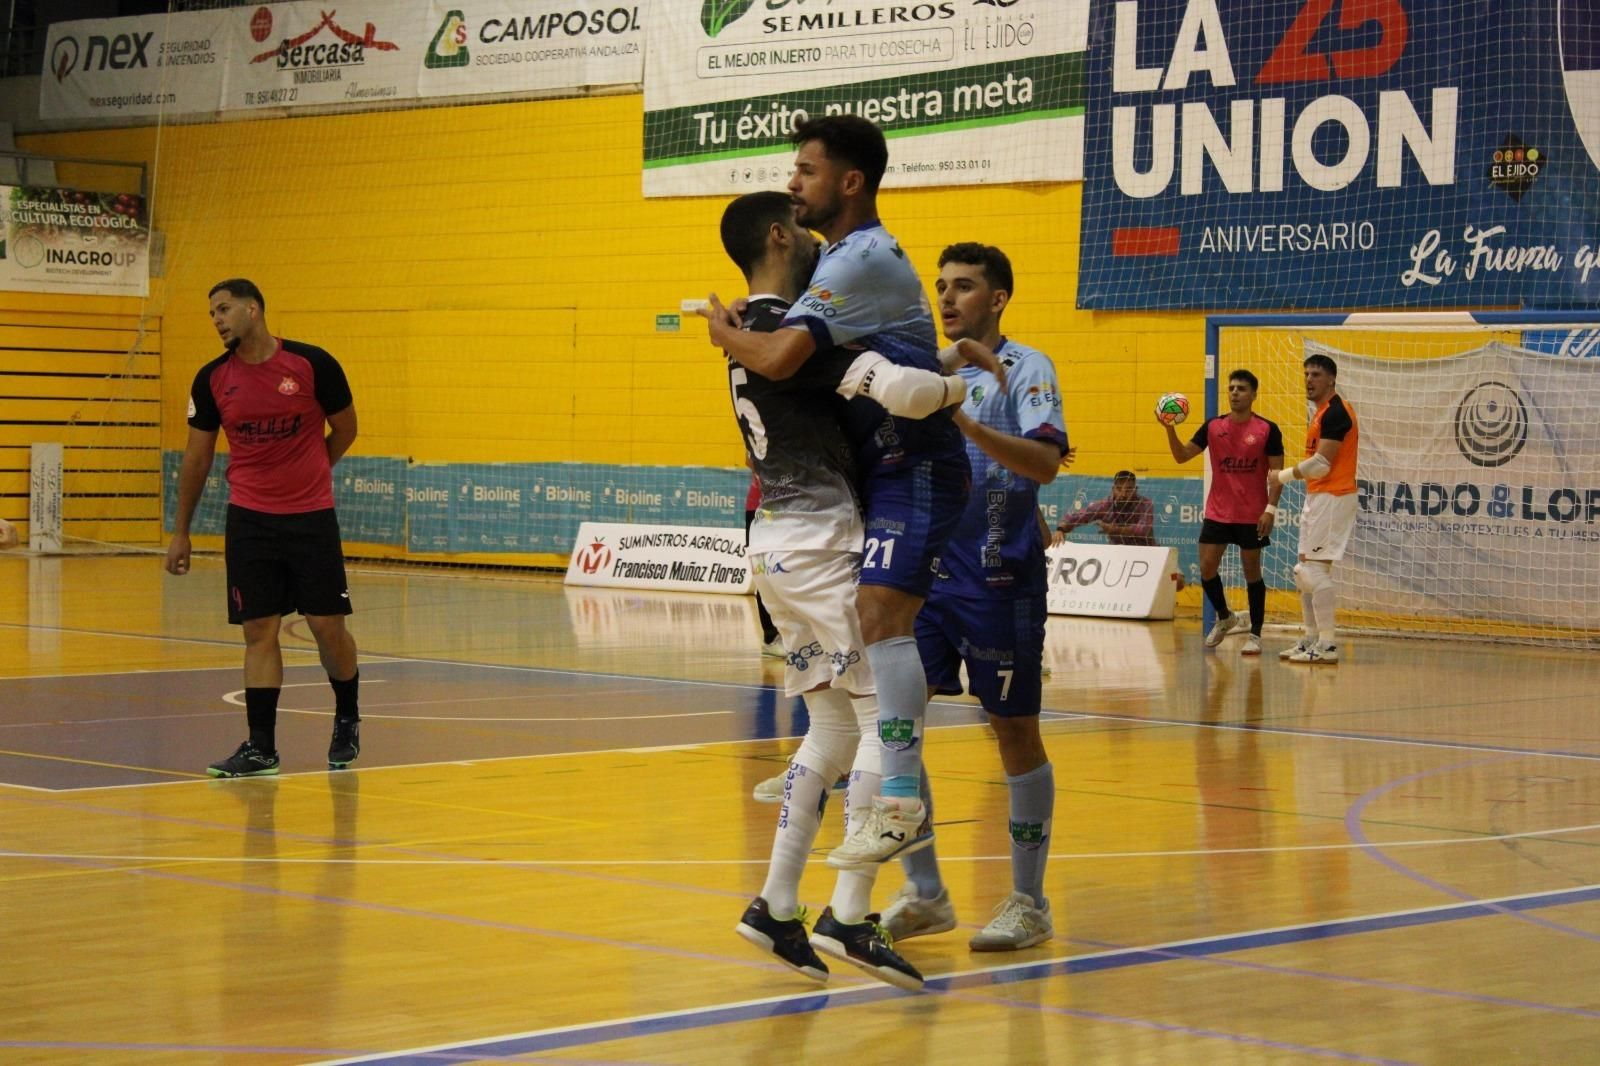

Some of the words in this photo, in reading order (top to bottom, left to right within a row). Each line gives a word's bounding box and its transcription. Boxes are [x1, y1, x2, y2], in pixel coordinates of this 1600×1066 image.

[479, 7, 641, 43] CAMPOSOL
[762, 2, 956, 34] SEMILLEROS
[83, 32, 154, 71] nex
[159, 40, 211, 53] SEGURIDAD
[277, 39, 365, 68] Sercasa
[475, 53, 522, 66] SOCIEDAD
[525, 48, 588, 63] COOPERATIVA
[589, 43, 640, 57] ANDALUZA
[708, 56, 722, 69] EL
[725, 52, 767, 68] MEJOR
[770, 47, 821, 64] INJERTO
[825, 45, 857, 60] PARA
[857, 43, 877, 58] TU
[879, 38, 942, 57] COSECHA
[1112, 0, 1237, 92] LA
[294, 69, 342, 84] INMOBILIARIA
[90, 92, 177, 109] nexseguridad.com
[693, 111, 727, 146] Tu
[953, 72, 1033, 113] meta
[1112, 87, 1459, 199] UNION
[902, 162, 937, 173] Teléfono:
[938, 161, 954, 171] 950
[955, 160, 967, 170] 33
[968, 160, 980, 170] 01
[981, 159, 991, 169] 01
[1492, 166, 1504, 178] EL
[1506, 164, 1539, 177] EJIDO
[17, 201, 86, 214] ESPECIALISTAS
[88, 205, 100, 215] EN
[1200, 221, 1375, 254] ANIVERSARIO
[46, 249, 137, 267] INAGROUP
[1401, 229, 1457, 286] La
[1463, 224, 1563, 280] Fuerza
[801, 297, 836, 317] EJIDO
[354, 478, 394, 494] Bioline
[473, 486, 520, 501] Bioline
[546, 485, 592, 502] Bioline
[615, 489, 662, 506] Bioline
[687, 491, 735, 508] Bioline
[1357, 479, 1480, 517] RIADO
[1486, 484, 1515, 519] &
[987, 489, 1007, 567] Bioline
[1535, 528, 1543, 537] A
[1549, 528, 1567, 540] TU
[619, 533, 687, 551] SUMINISTROS
[862, 537, 895, 570] 21
[612, 558, 668, 580] Francisco
[669, 561, 707, 582] Muñoz
[708, 563, 747, 585] Flores
[997, 670, 1014, 701] 7
